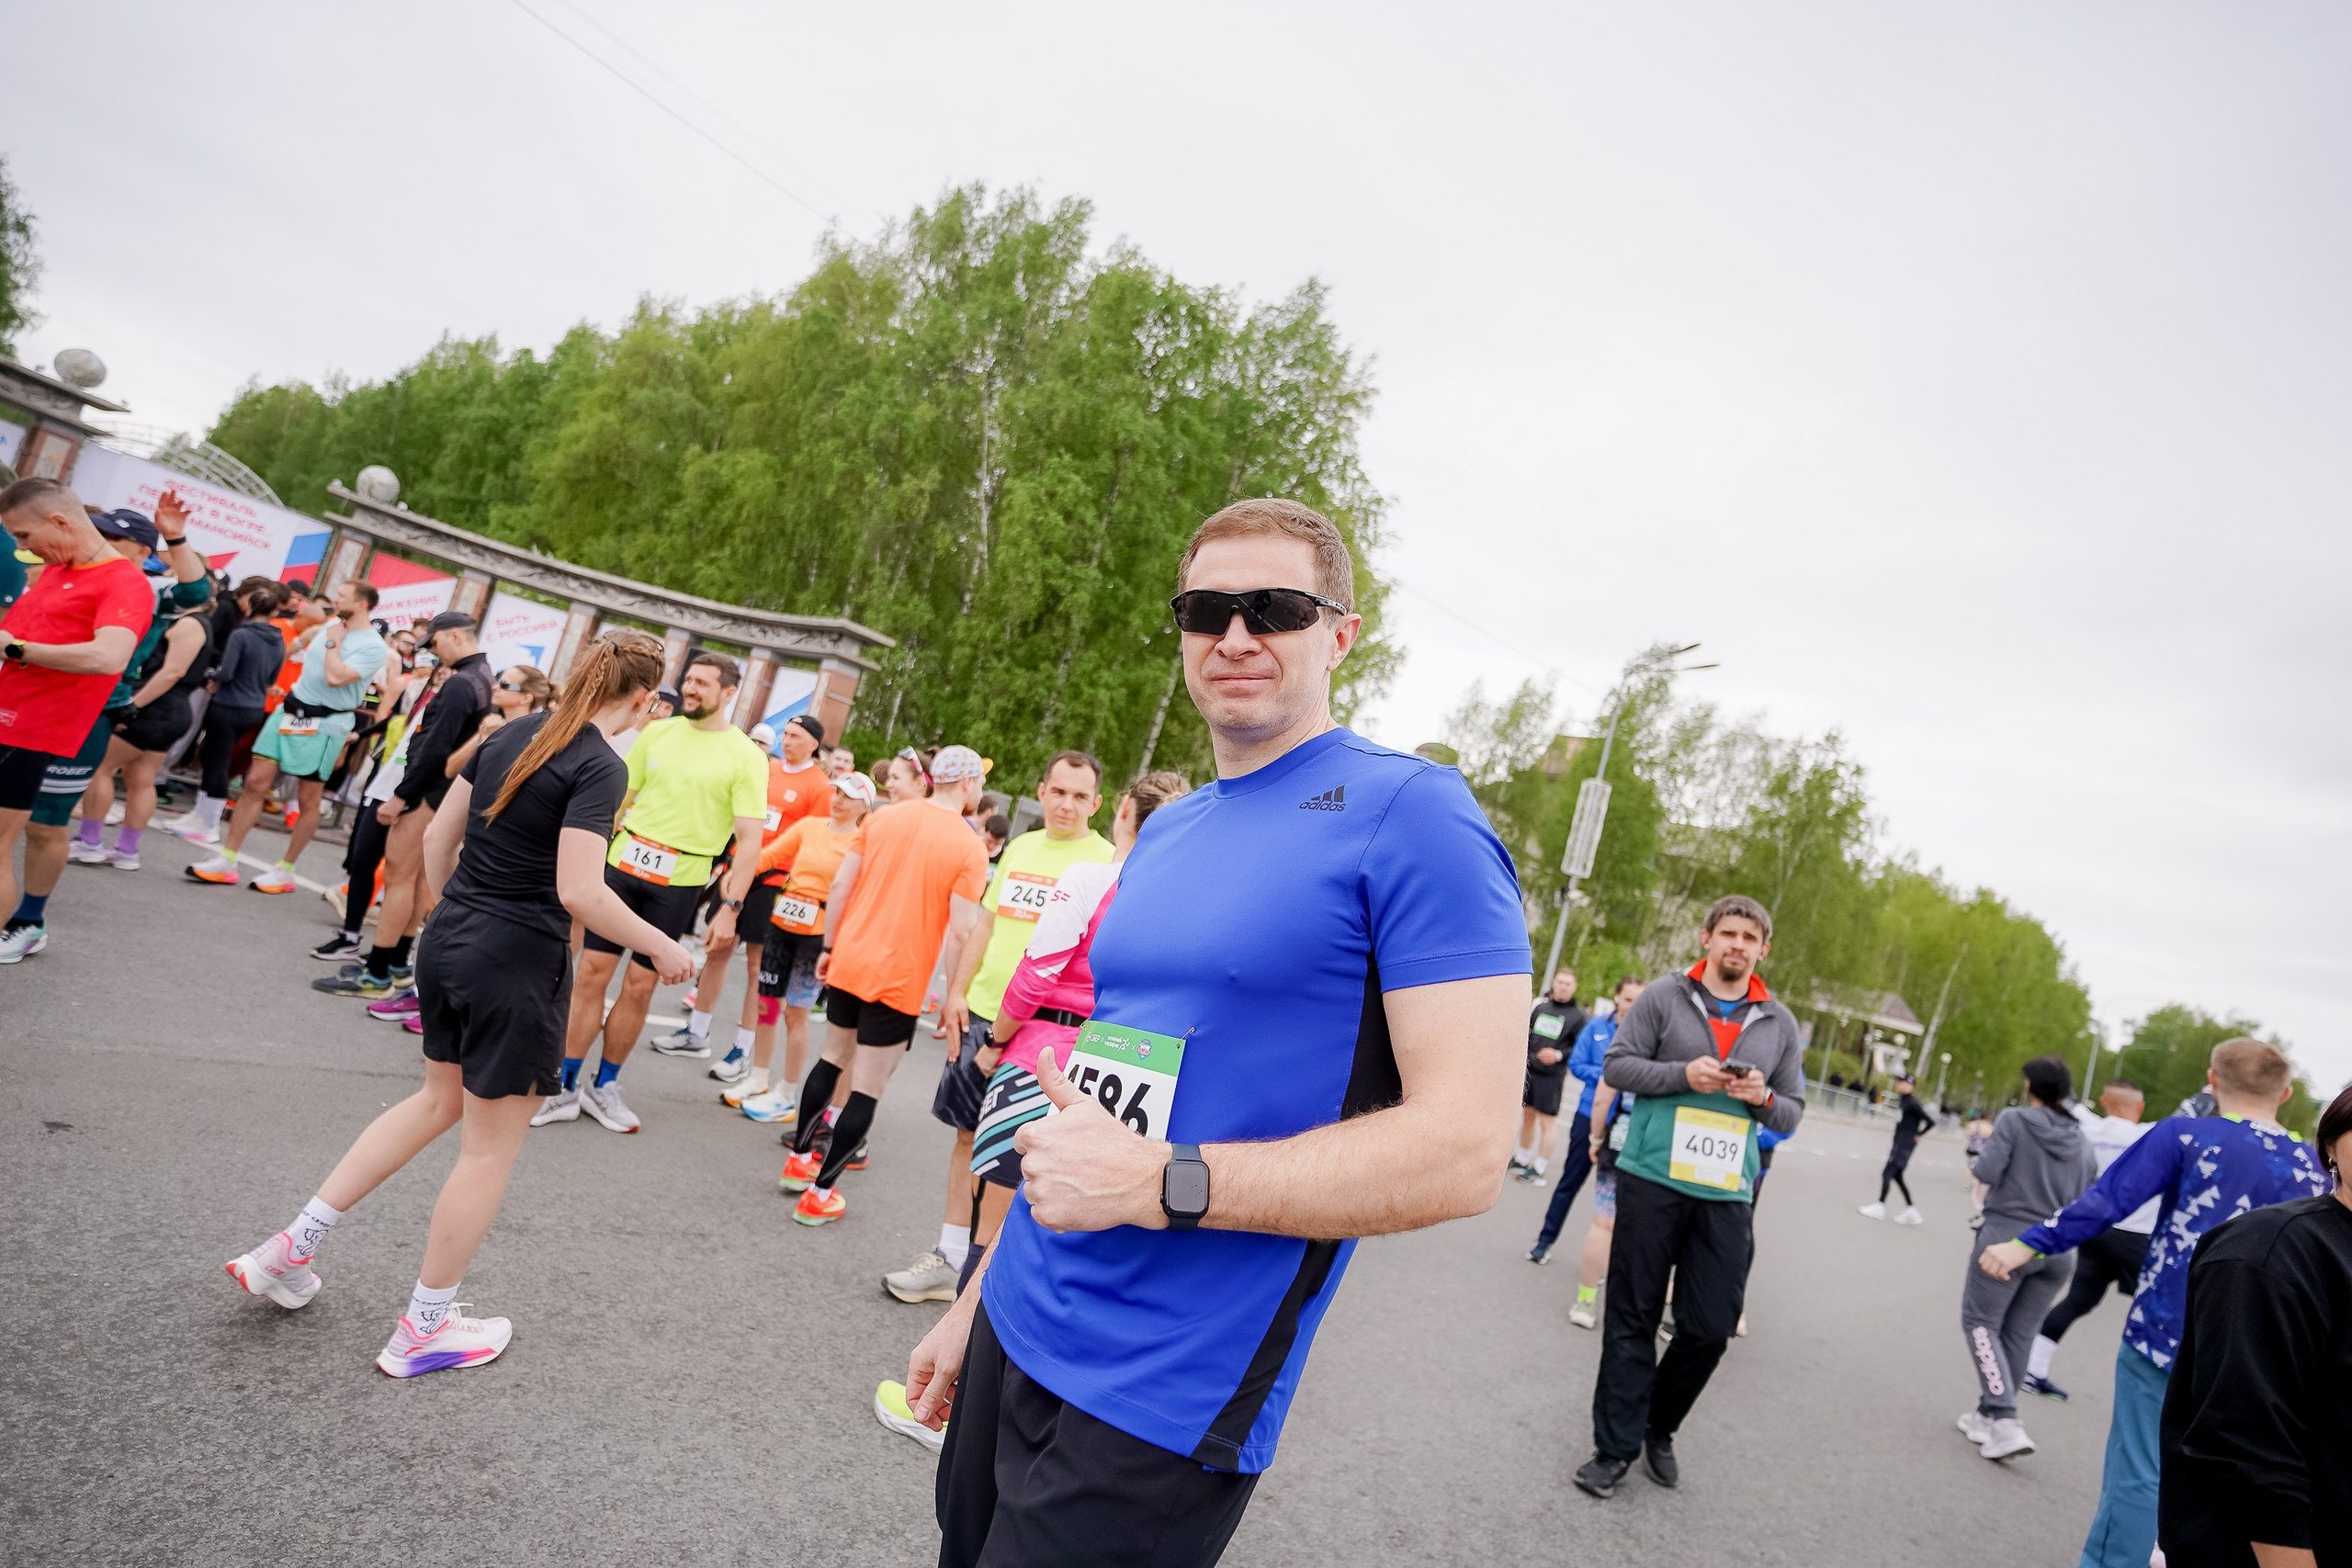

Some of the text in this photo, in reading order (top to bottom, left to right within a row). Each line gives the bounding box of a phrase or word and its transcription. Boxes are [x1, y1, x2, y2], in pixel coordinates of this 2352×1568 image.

[495, 614, 531, 628] БЫТЬ
[499, 618, 560, 639] РОССИЕЙ
[1298, 799, 1346, 812] adidas
[634, 847, 662, 869] 161
[1011, 886, 1047, 908] 245
[782, 901, 807, 919] 226
[1685, 1134, 1738, 1162] 4039
